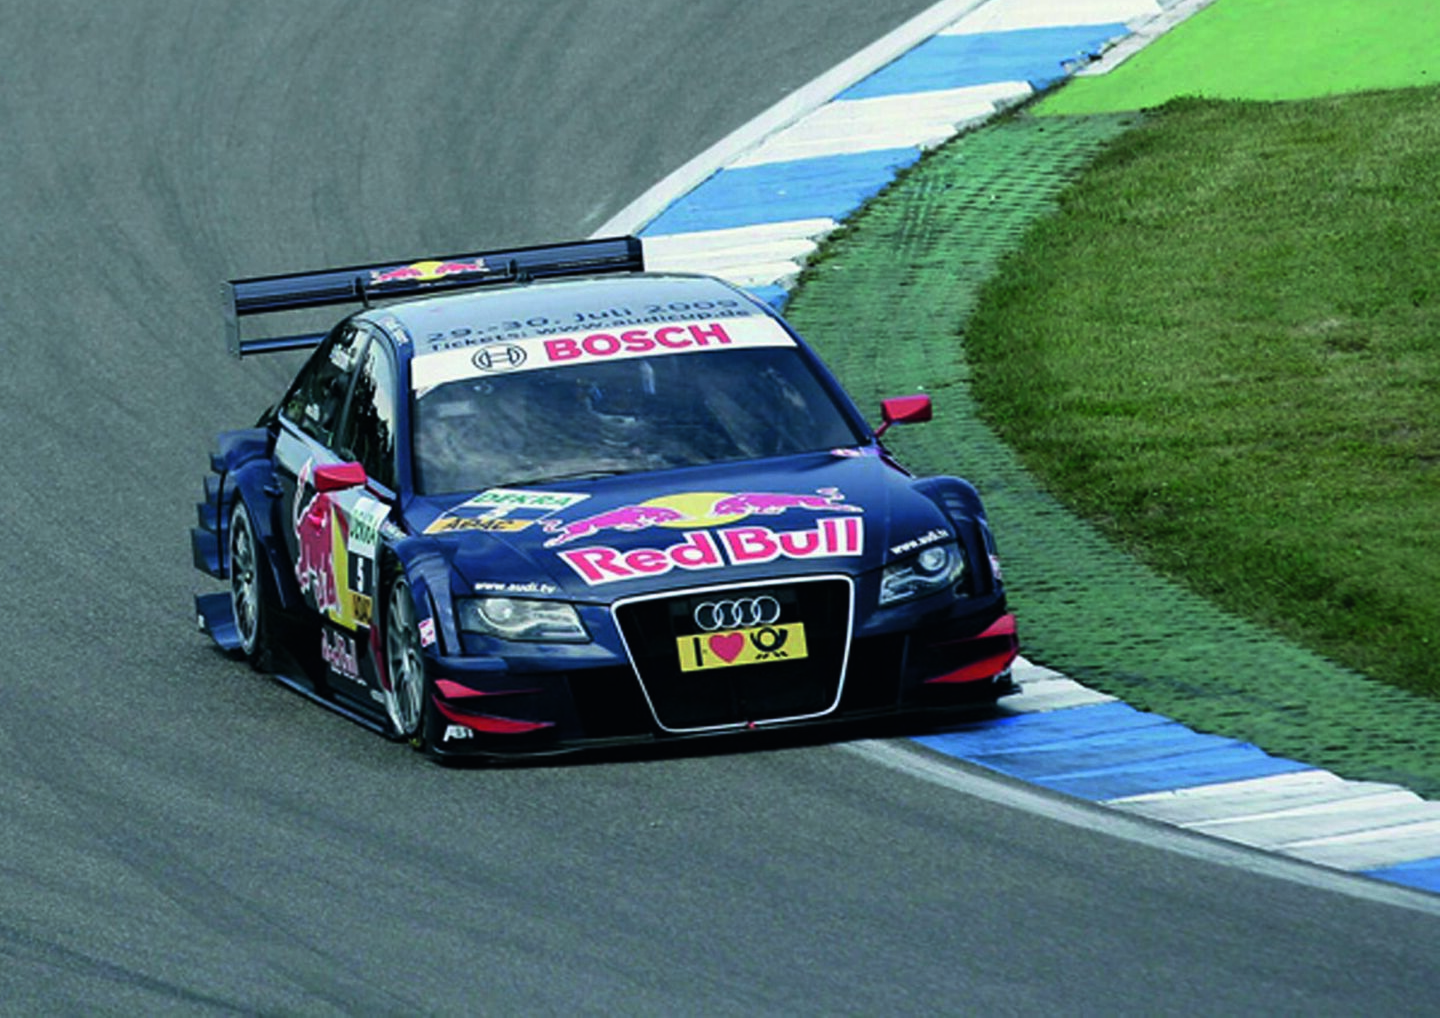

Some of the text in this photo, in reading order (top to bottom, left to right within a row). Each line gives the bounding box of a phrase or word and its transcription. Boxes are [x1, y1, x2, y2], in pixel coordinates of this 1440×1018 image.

[647, 298, 740, 312] 2009
[536, 309, 751, 336] www.audicup.de
[543, 323, 732, 362] BOSCH
[472, 492, 574, 507] DEKRA
[566, 518, 858, 582] Red Bull
[474, 582, 557, 594] www.audi.tv
[692, 637, 703, 667] I
